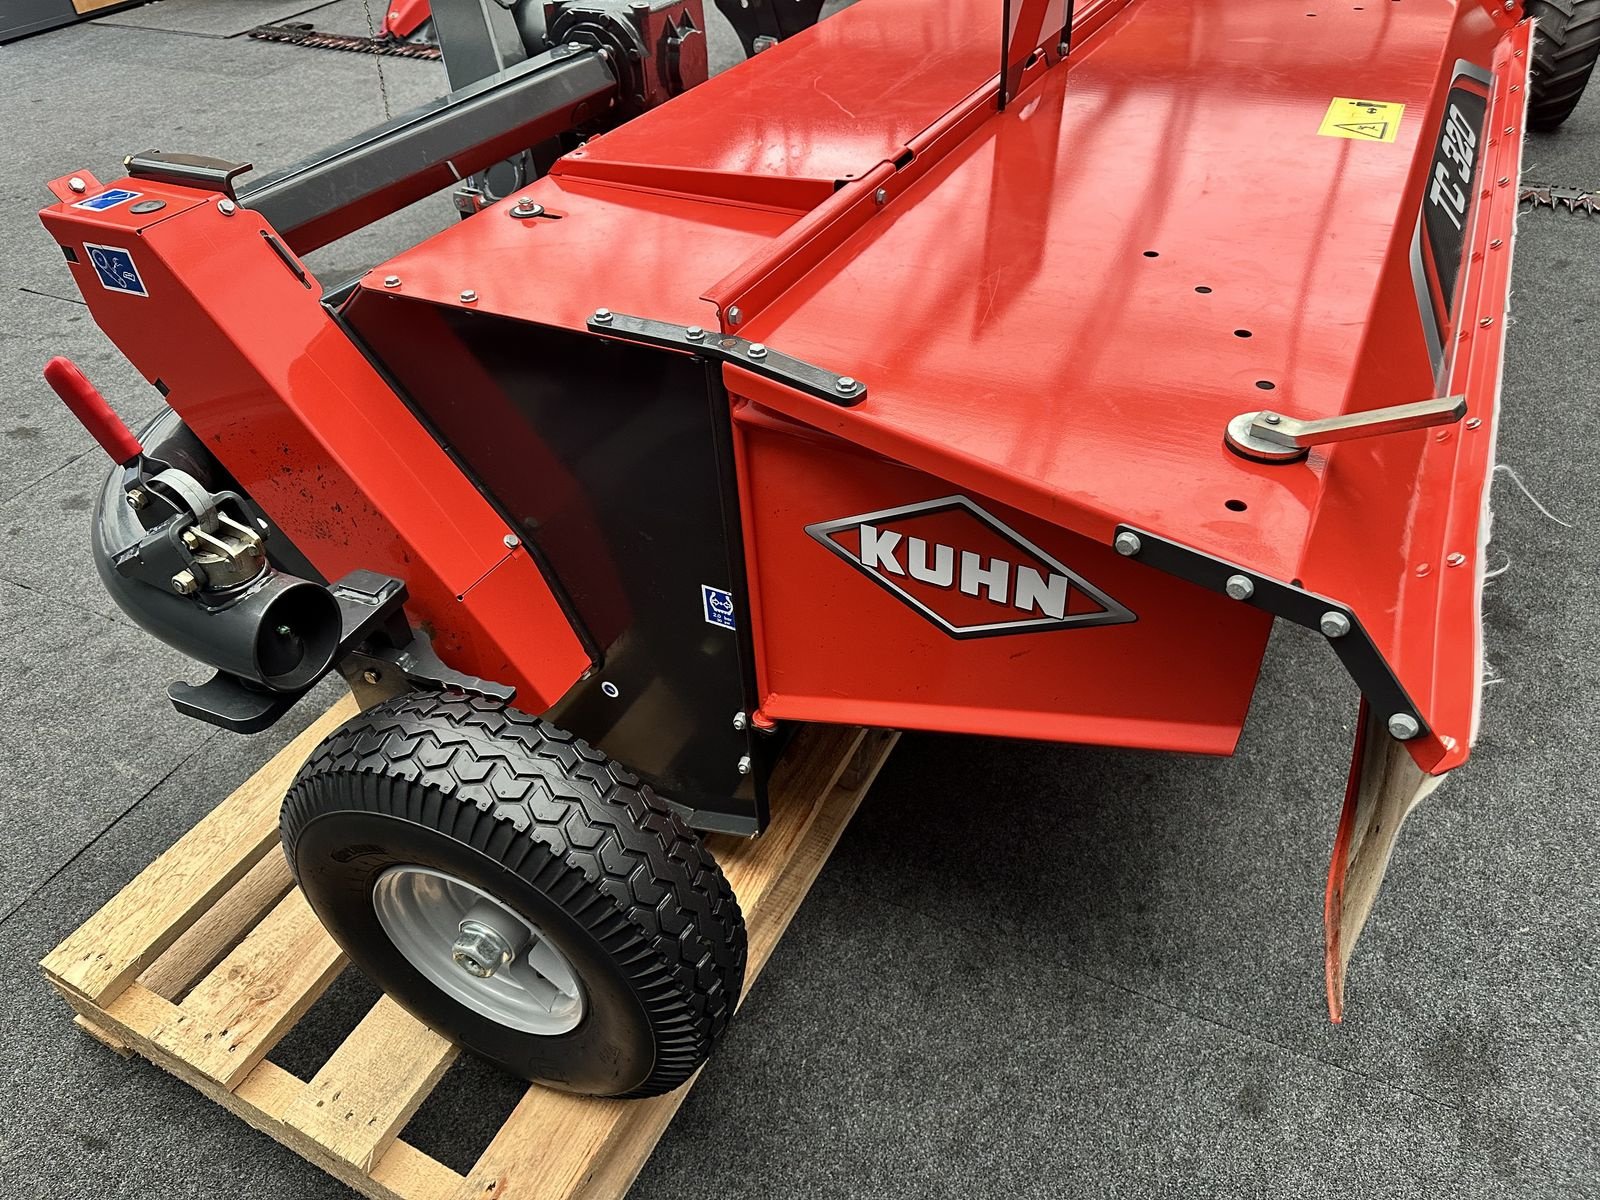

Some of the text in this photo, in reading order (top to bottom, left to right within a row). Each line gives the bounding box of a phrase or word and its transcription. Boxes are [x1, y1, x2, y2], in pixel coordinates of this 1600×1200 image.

[1430, 103, 1476, 230] TC 320
[860, 523, 1068, 619] KUHN
